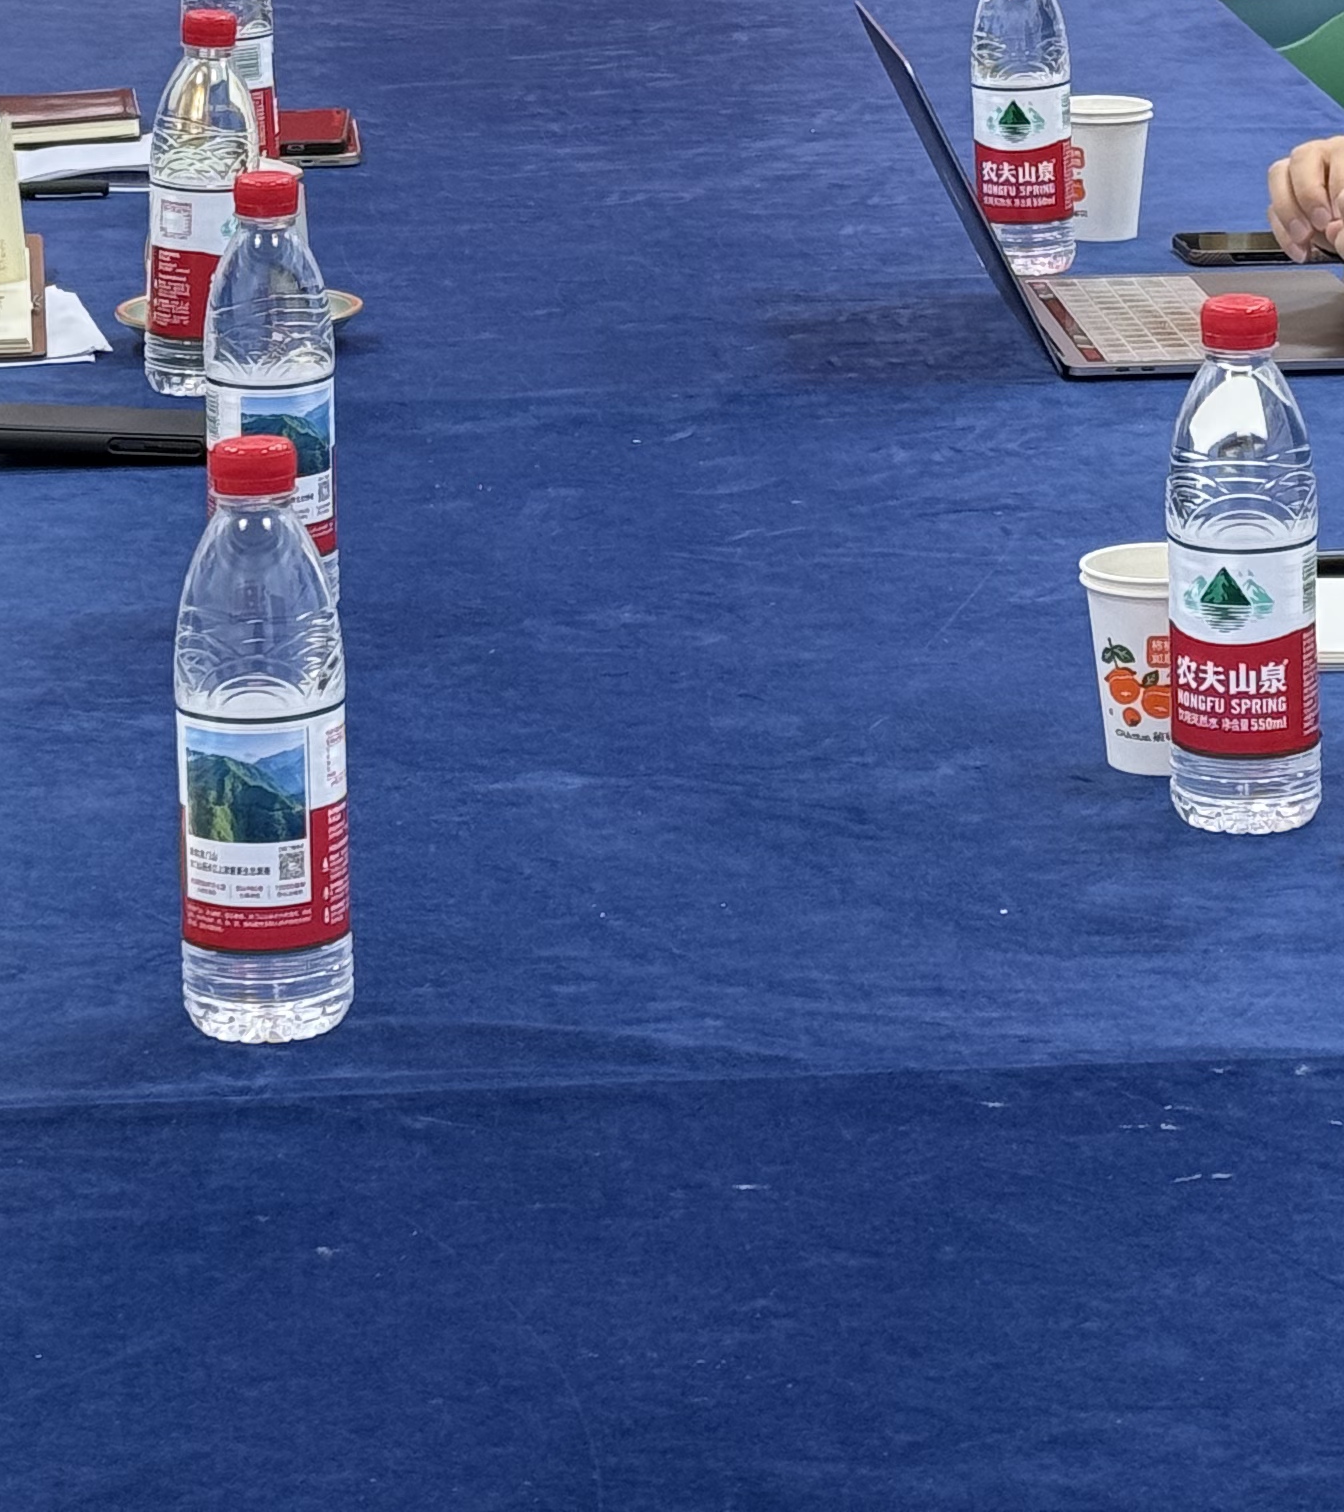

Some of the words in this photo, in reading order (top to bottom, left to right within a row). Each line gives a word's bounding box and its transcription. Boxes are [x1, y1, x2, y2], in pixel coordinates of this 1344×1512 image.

[982, 160, 1056, 184] 农夫山泉
[1176, 655, 1288, 696] 农夫山泉
[1177, 688, 1226, 714] NONGFU
[1230, 696, 1288, 715] SPRING
